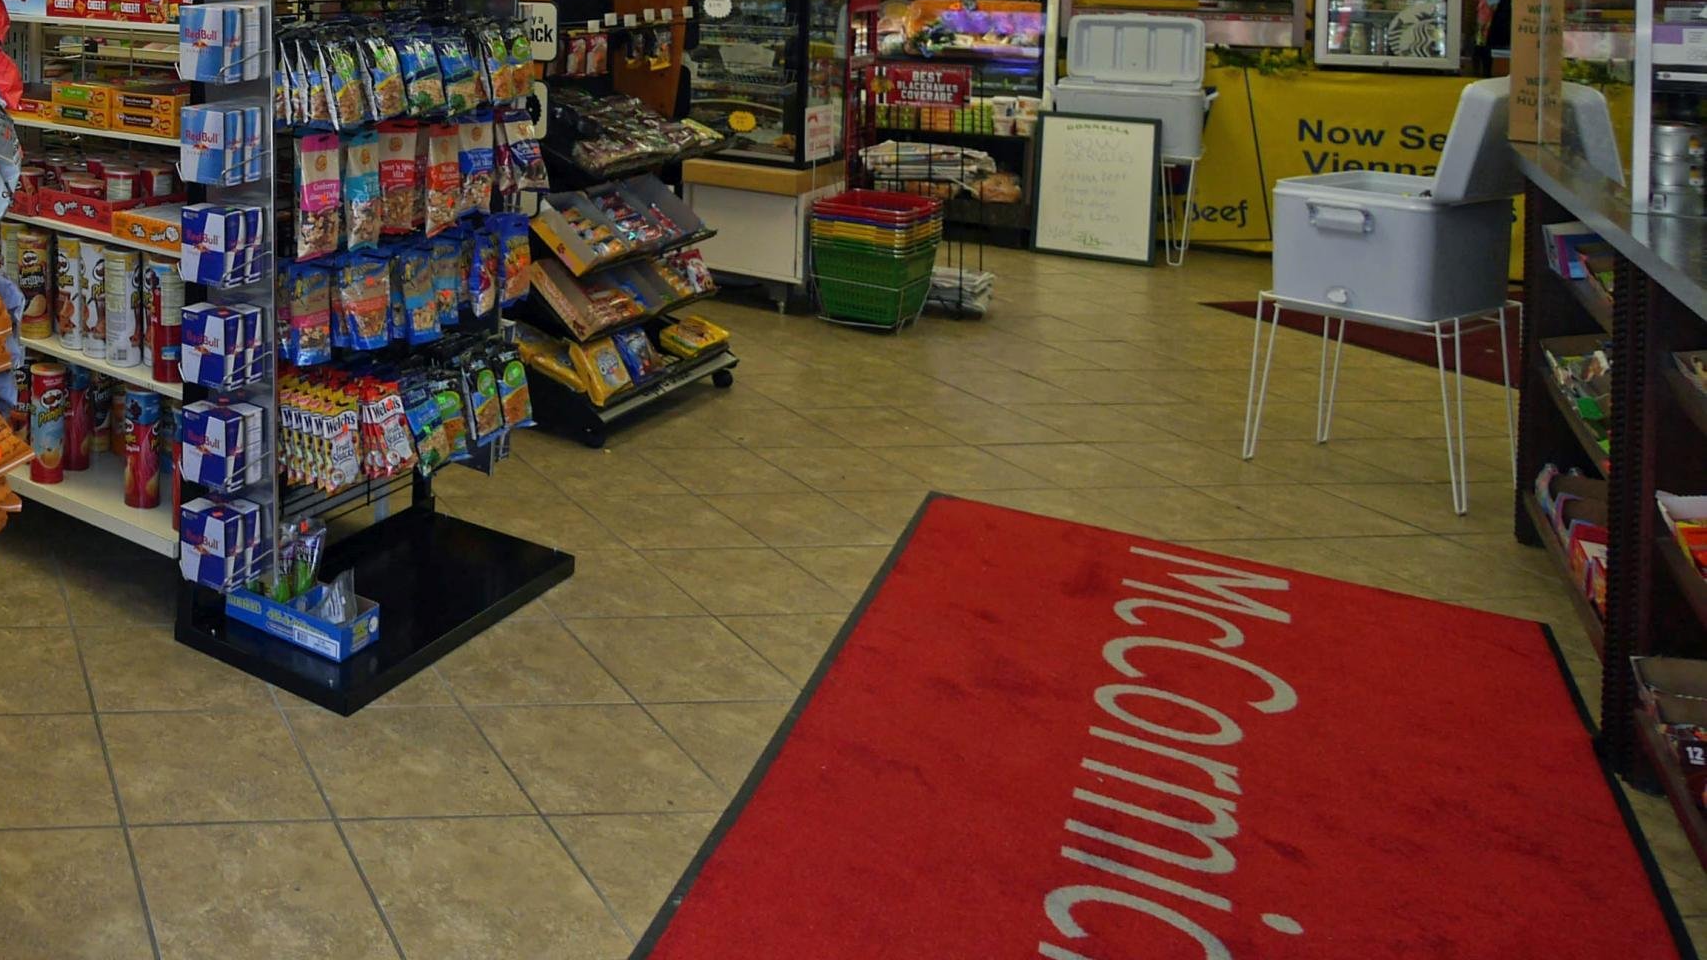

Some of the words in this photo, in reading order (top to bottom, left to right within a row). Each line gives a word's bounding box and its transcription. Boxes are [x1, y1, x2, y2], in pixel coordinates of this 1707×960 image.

[912, 71, 942, 83] BEST
[896, 80, 959, 94] BLACKHAWKS
[900, 90, 954, 103] COVERAGE
[1298, 118, 1386, 146] Now
[1182, 199, 1249, 228] Beef
[325, 414, 356, 434] Welch's
[333, 450, 354, 463] Snacks
[1039, 546, 1304, 960] McCormic
